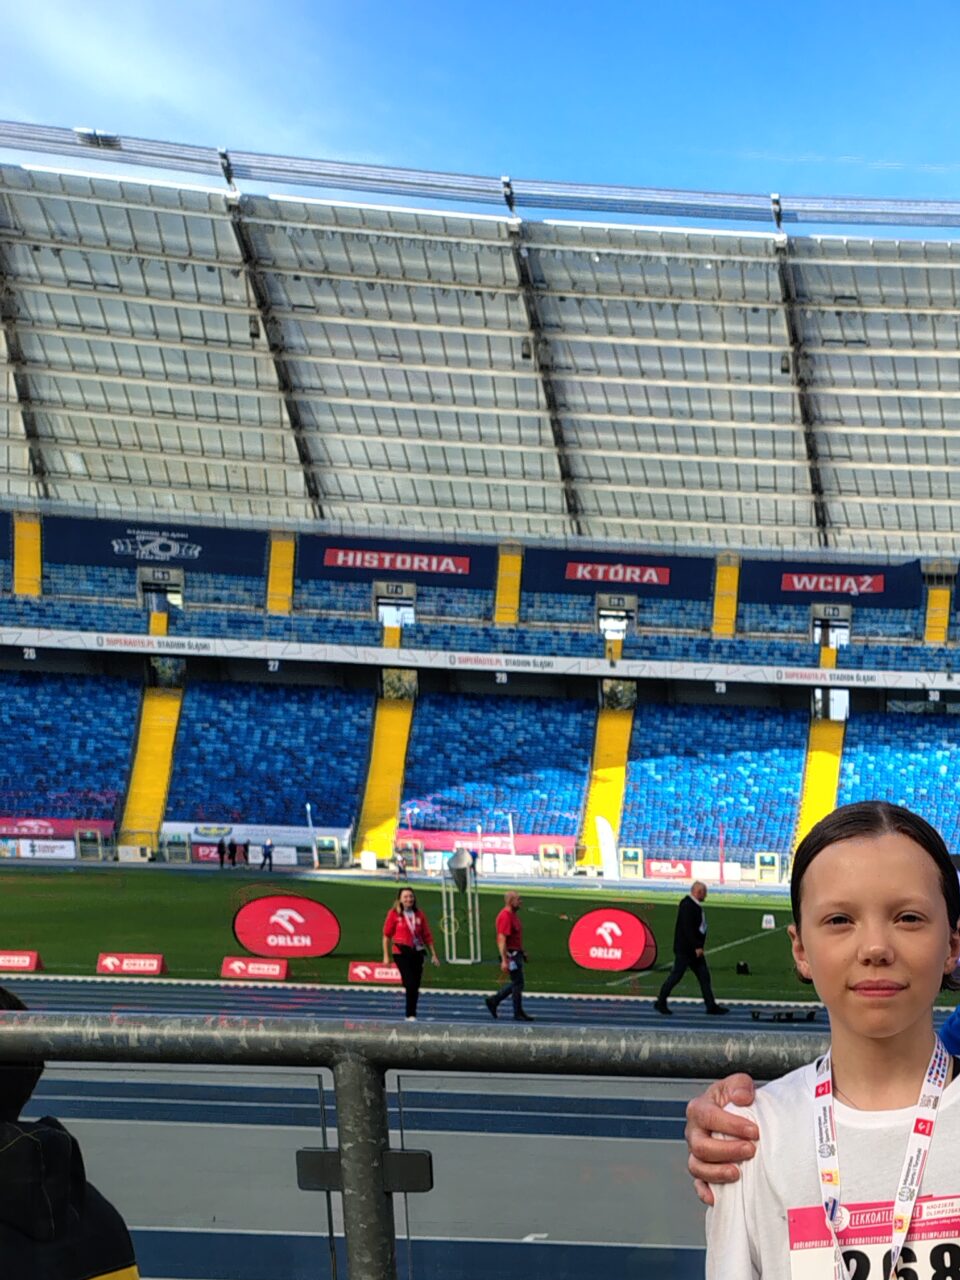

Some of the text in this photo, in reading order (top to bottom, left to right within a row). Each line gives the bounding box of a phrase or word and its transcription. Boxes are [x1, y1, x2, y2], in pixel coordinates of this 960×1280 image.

[336, 550, 464, 574] HISTORIA.
[575, 563, 659, 583] KTÓRA
[791, 574, 874, 596] WCIĄŻ
[266, 934, 312, 947] ORLEN
[589, 946, 622, 960] ORLEN
[377, 969, 401, 978] ORLE
